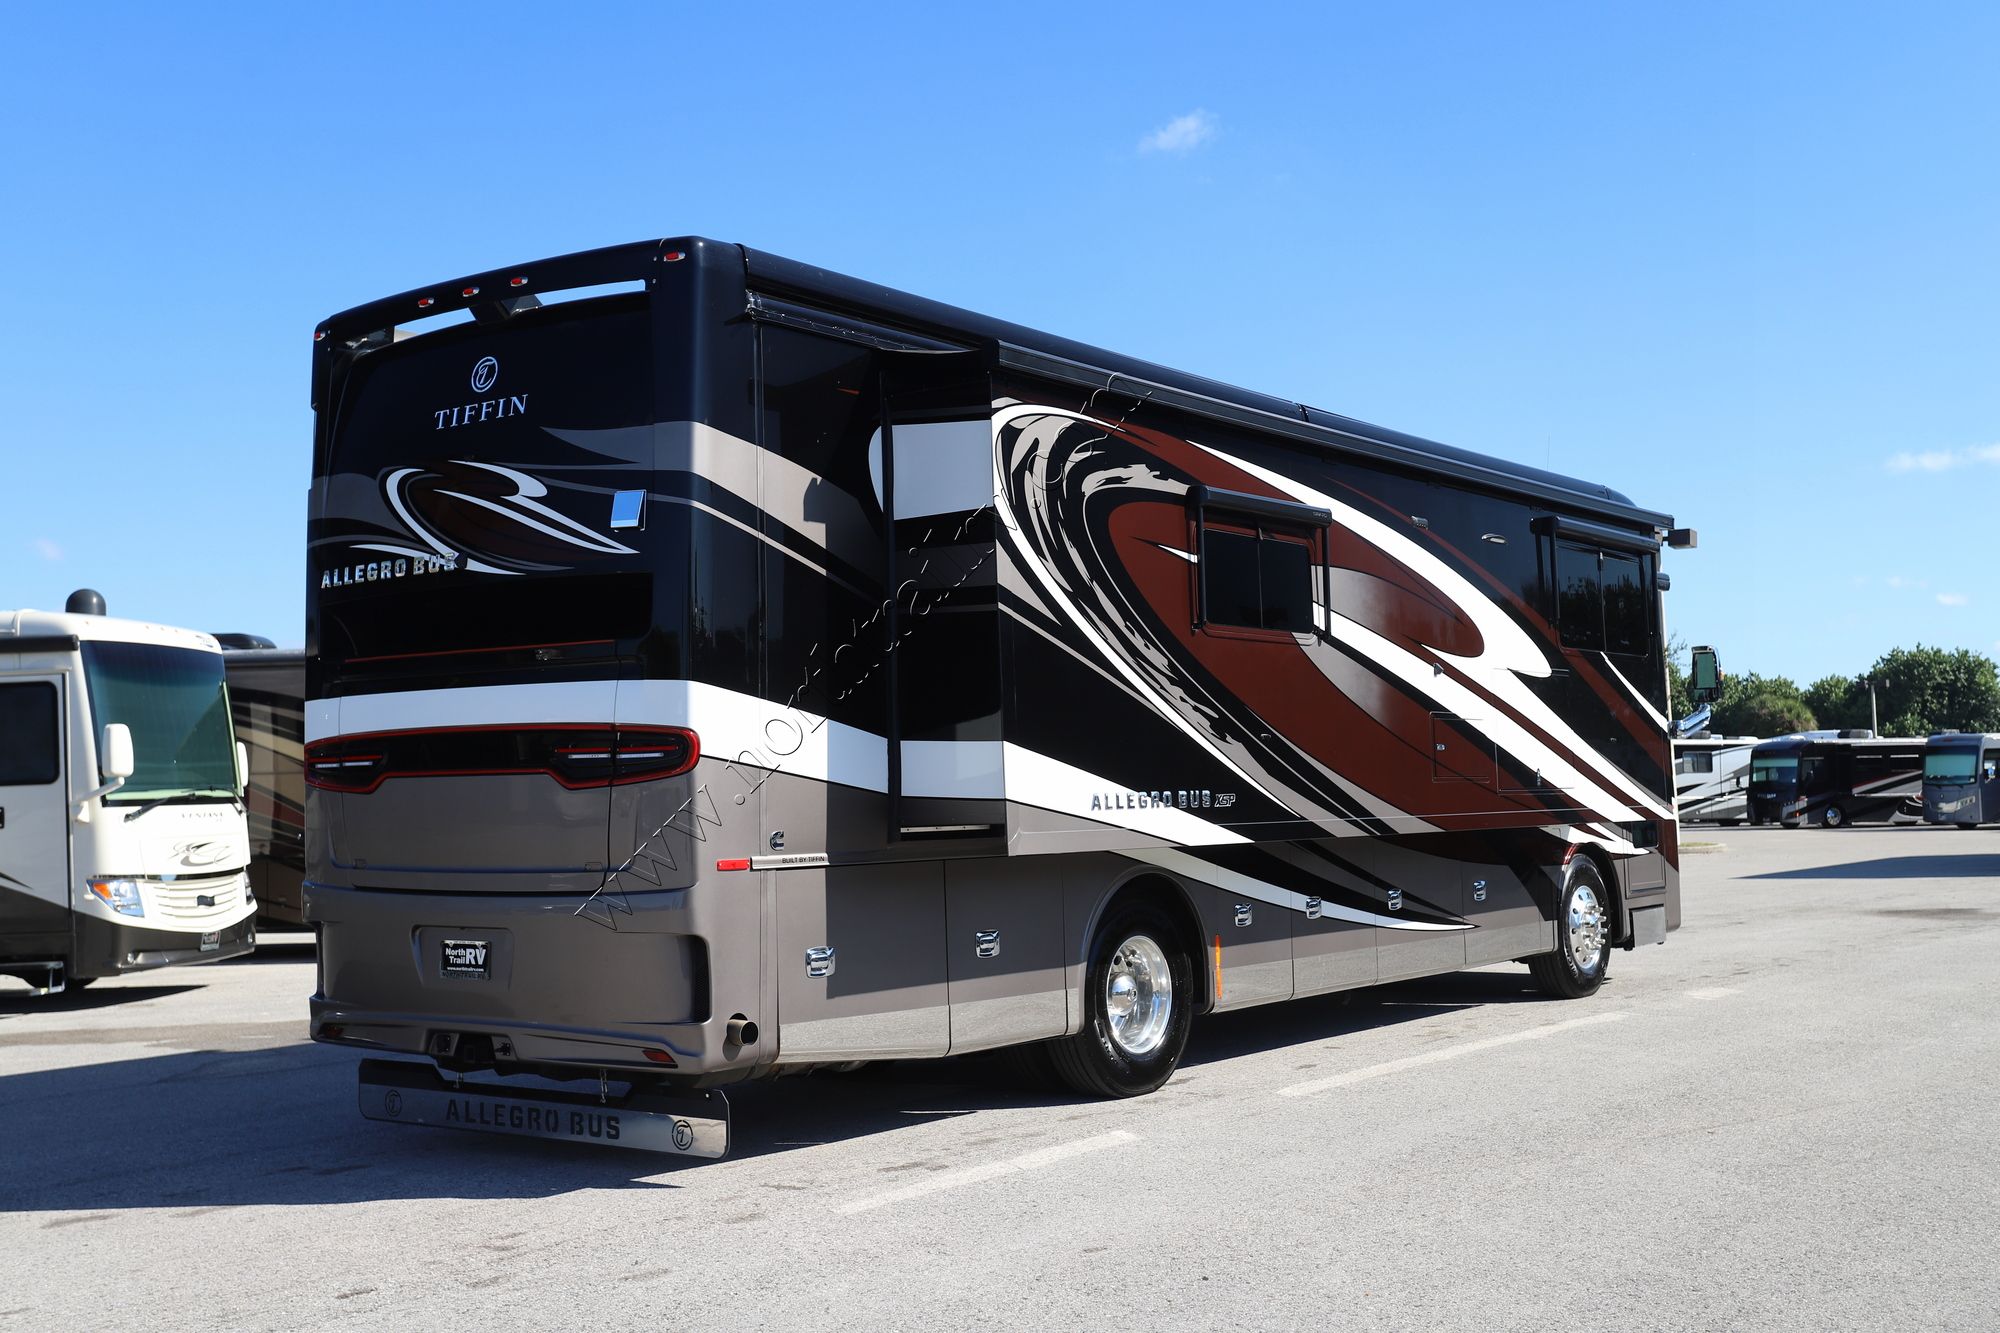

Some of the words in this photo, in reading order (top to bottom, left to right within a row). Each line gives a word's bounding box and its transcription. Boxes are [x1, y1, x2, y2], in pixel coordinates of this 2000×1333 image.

[434, 394, 529, 430] TIFFIN
[320, 558, 407, 589] ALLEGRO
[413, 552, 456, 576] BUS
[1091, 790, 1173, 811] ALLEGRO
[1178, 789, 1211, 808] BUS
[446, 947, 466, 956] North
[449, 956, 466, 964] Trail
[465, 948, 487, 965] RV
[446, 1098, 559, 1133] ALLEGRO
[569, 1110, 621, 1140] BUS
